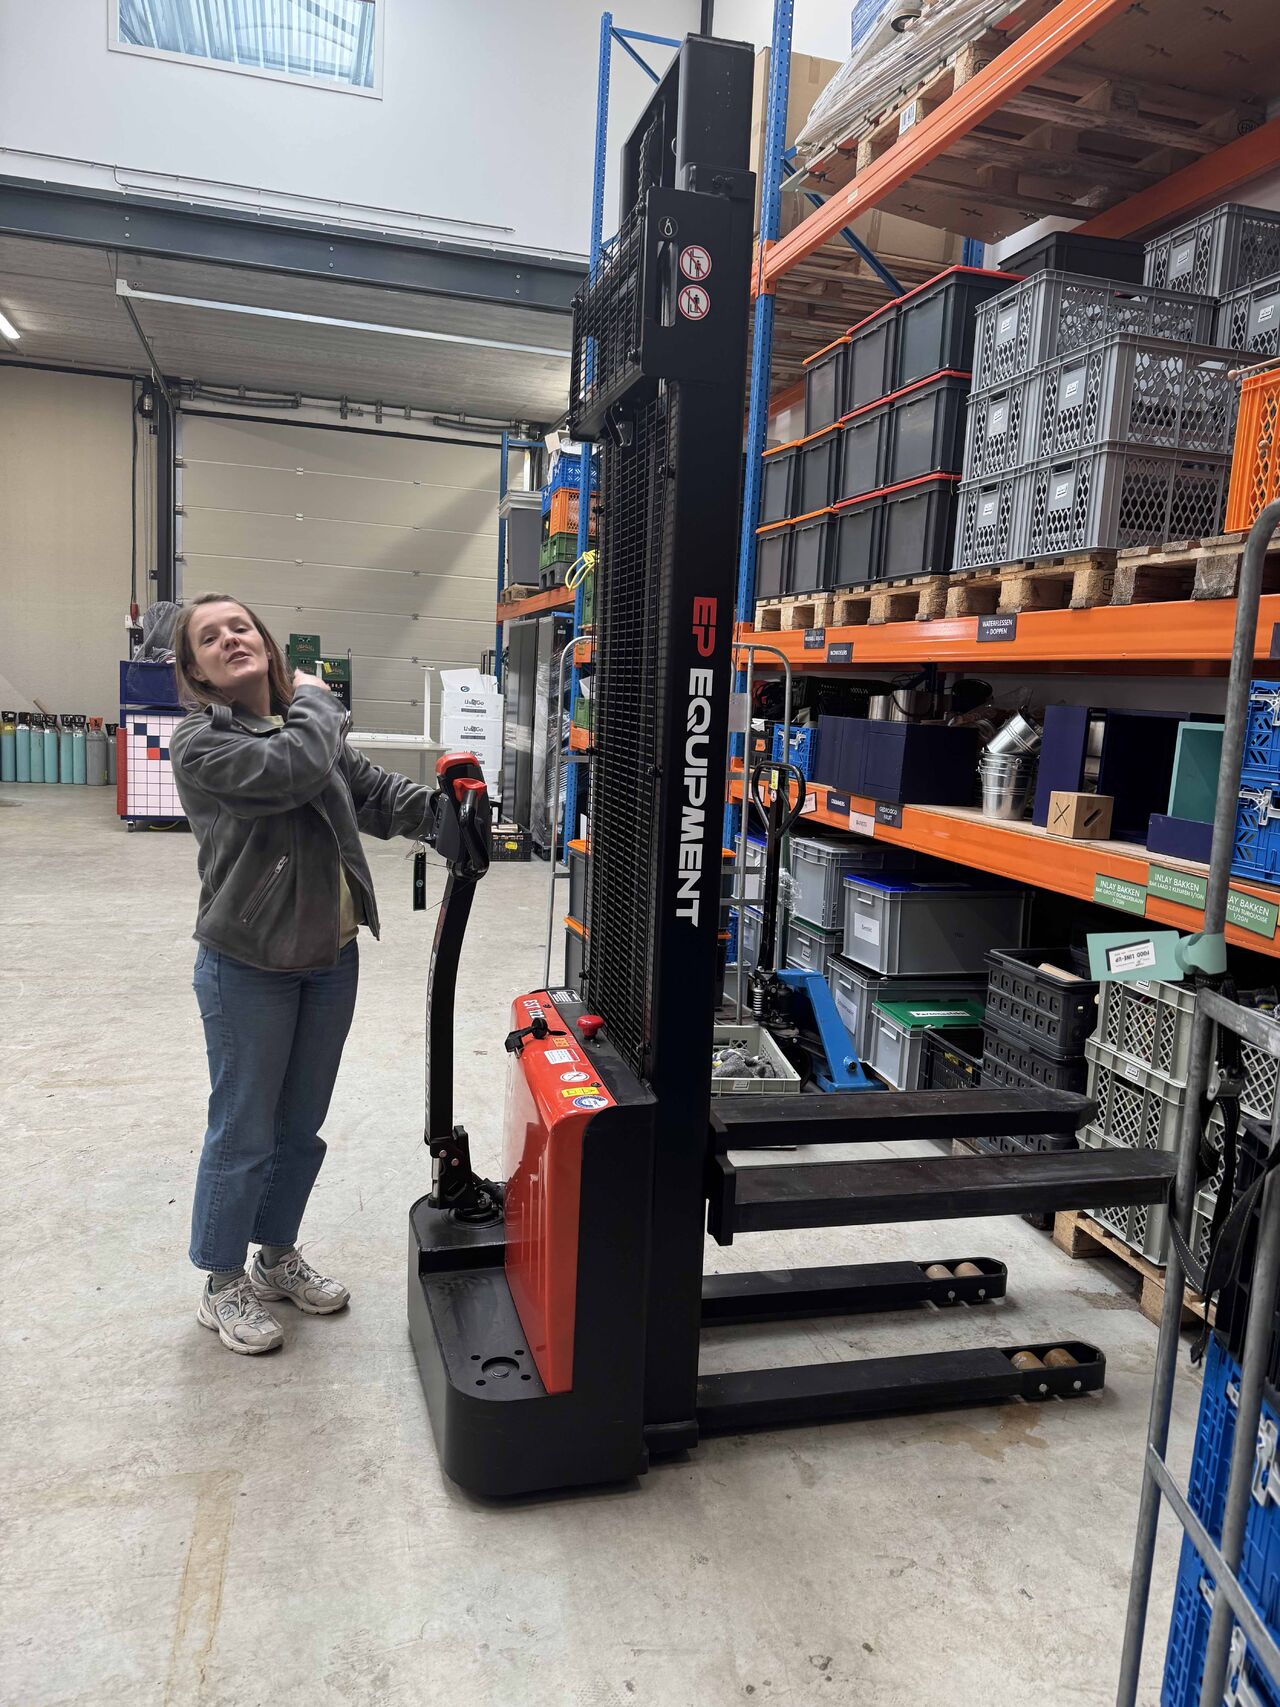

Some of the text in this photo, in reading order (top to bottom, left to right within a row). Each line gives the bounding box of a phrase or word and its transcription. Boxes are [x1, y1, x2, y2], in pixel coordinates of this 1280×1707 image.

[982, 619, 1013, 627] WATERFLESSEN
[675, 596, 718, 928] EP EQUIPMENT
[1100, 880, 1140, 897] INLAY BAKKEN
[1154, 873, 1200, 892] INLAY BAKKEN
[1239, 899, 1270, 916] BAKKEN
[220, 1305, 235, 1321] N
